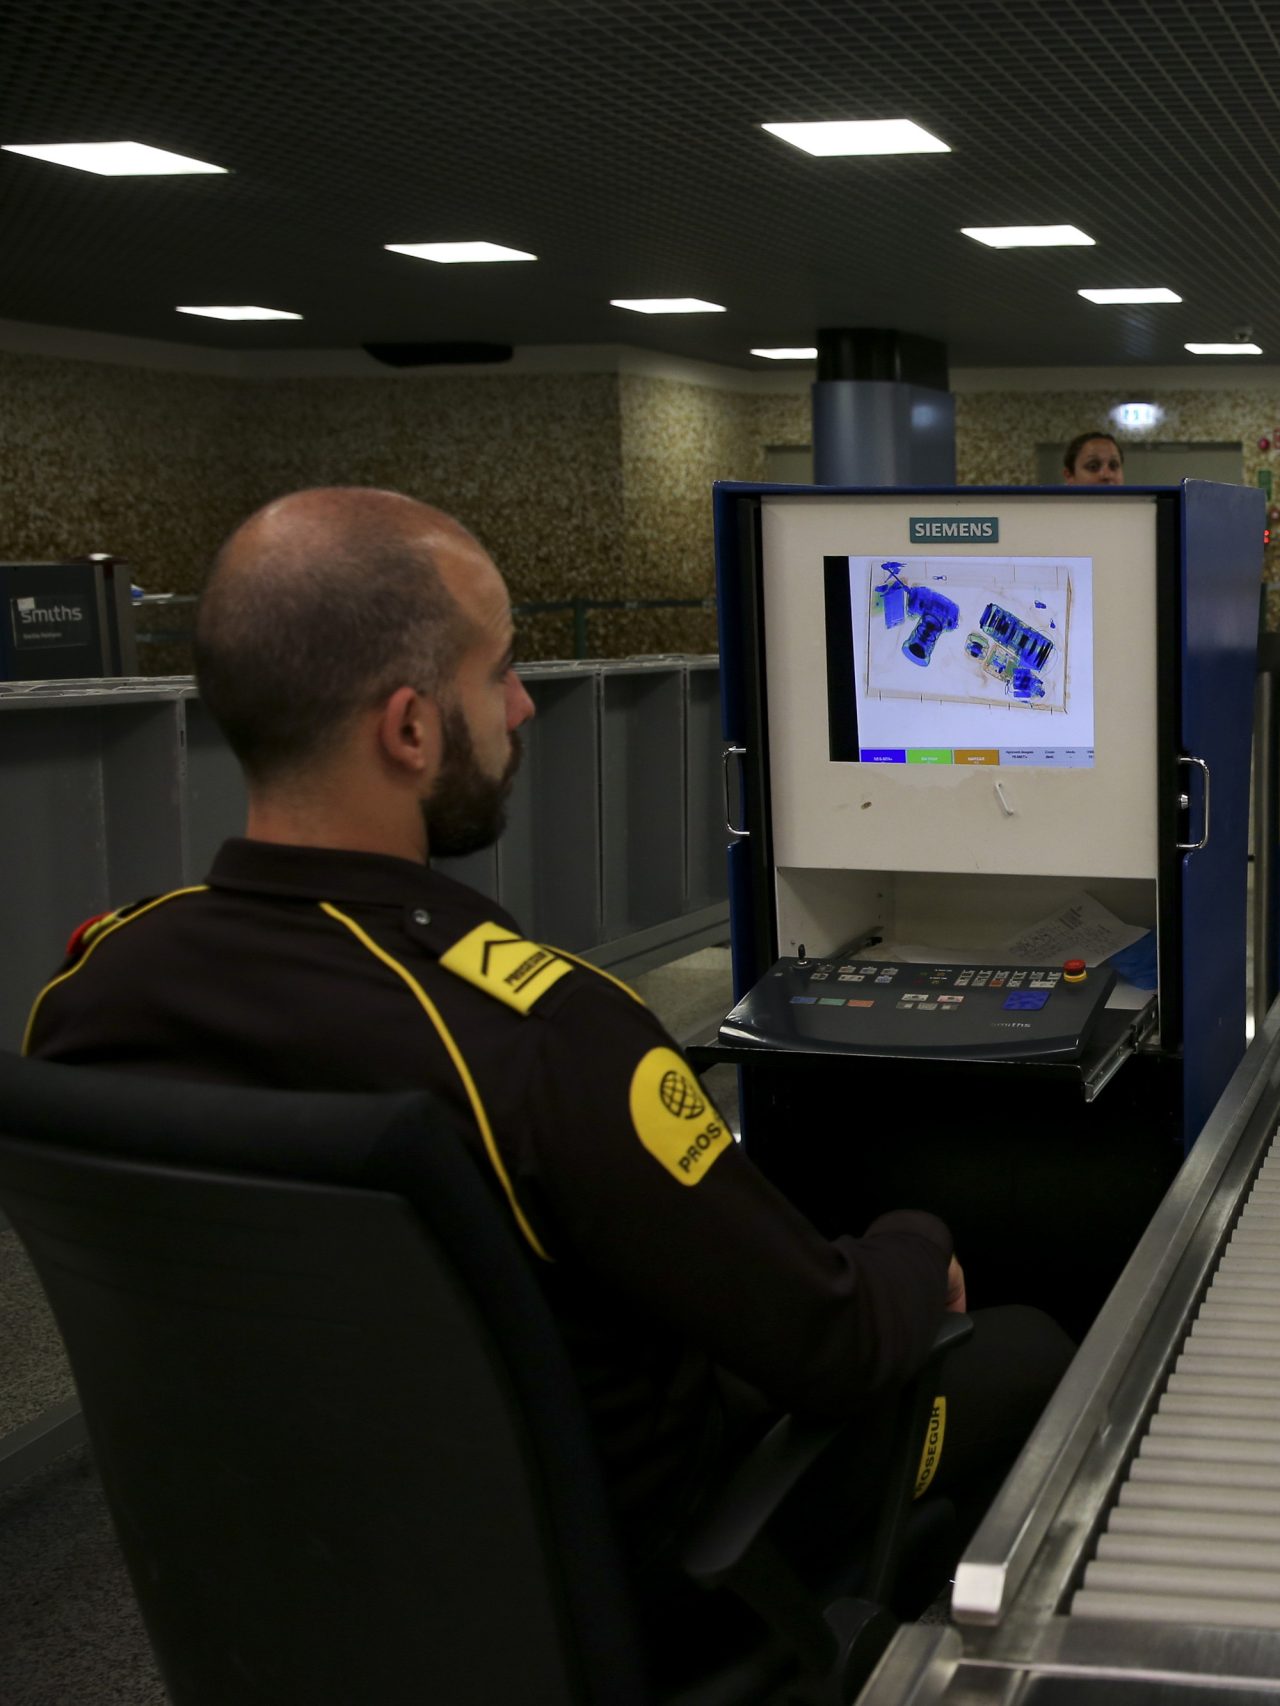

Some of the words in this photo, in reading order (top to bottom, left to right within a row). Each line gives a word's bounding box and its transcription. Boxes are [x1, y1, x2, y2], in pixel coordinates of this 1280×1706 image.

[914, 522, 993, 537] SIEMENS
[20, 604, 83, 624] smiths
[679, 1122, 722, 1173] PROS
